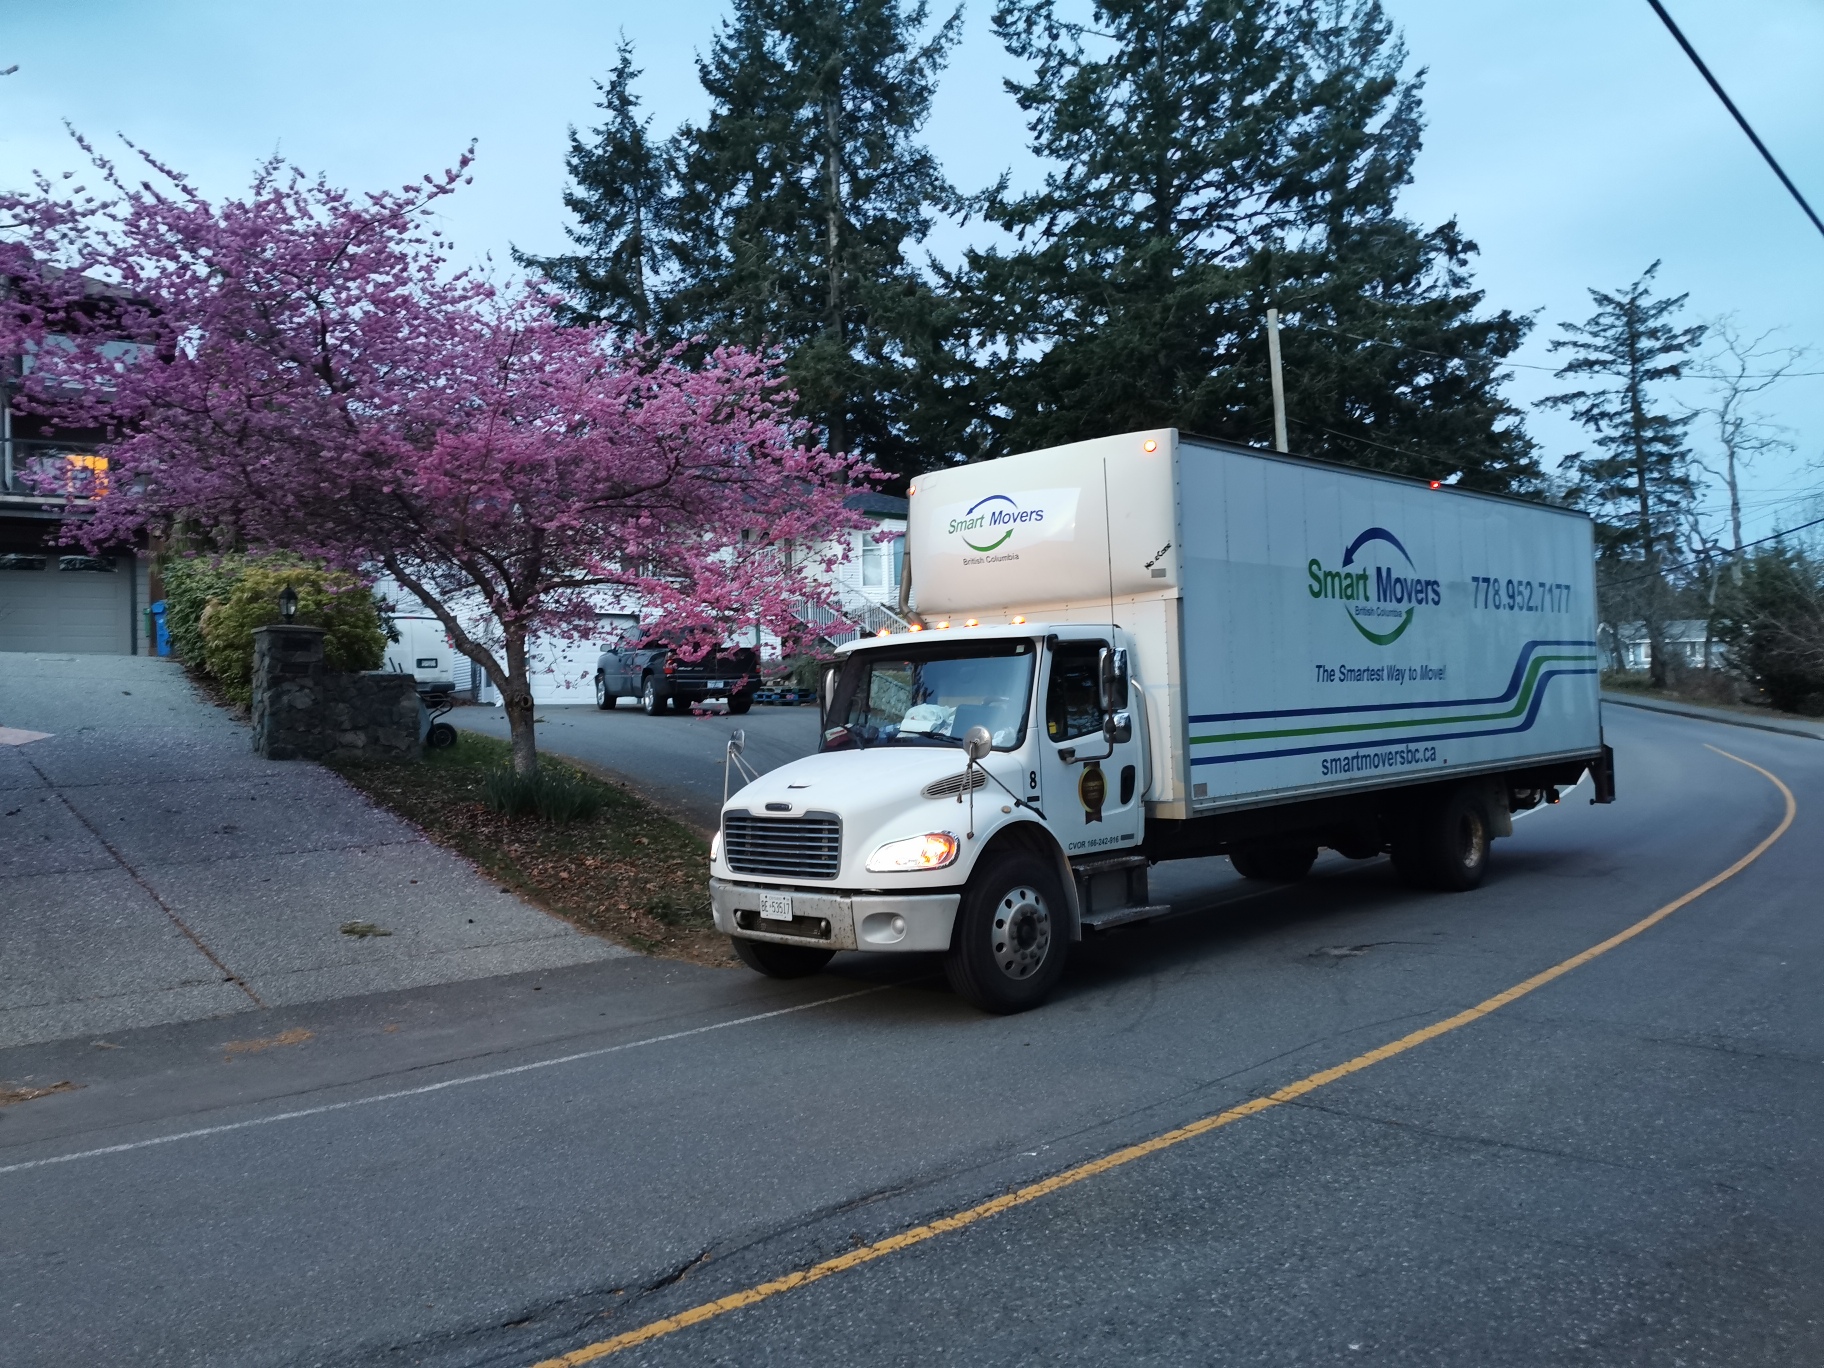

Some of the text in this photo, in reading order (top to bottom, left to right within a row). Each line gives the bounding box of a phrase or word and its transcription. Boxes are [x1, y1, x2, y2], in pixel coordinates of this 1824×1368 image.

[948, 509, 1044, 534] Smart Movers
[963, 553, 1020, 565] British Columbia
[1308, 558, 1441, 606] Smart Movers
[1471, 576, 1571, 613] 778.952.7177
[1315, 664, 1447, 685] The Smartest Way to Move!
[1321, 744, 1437, 776] smartmoversbc.ca
[1030, 770, 1037, 789] 8
[1068, 841, 1086, 850] CVOR
